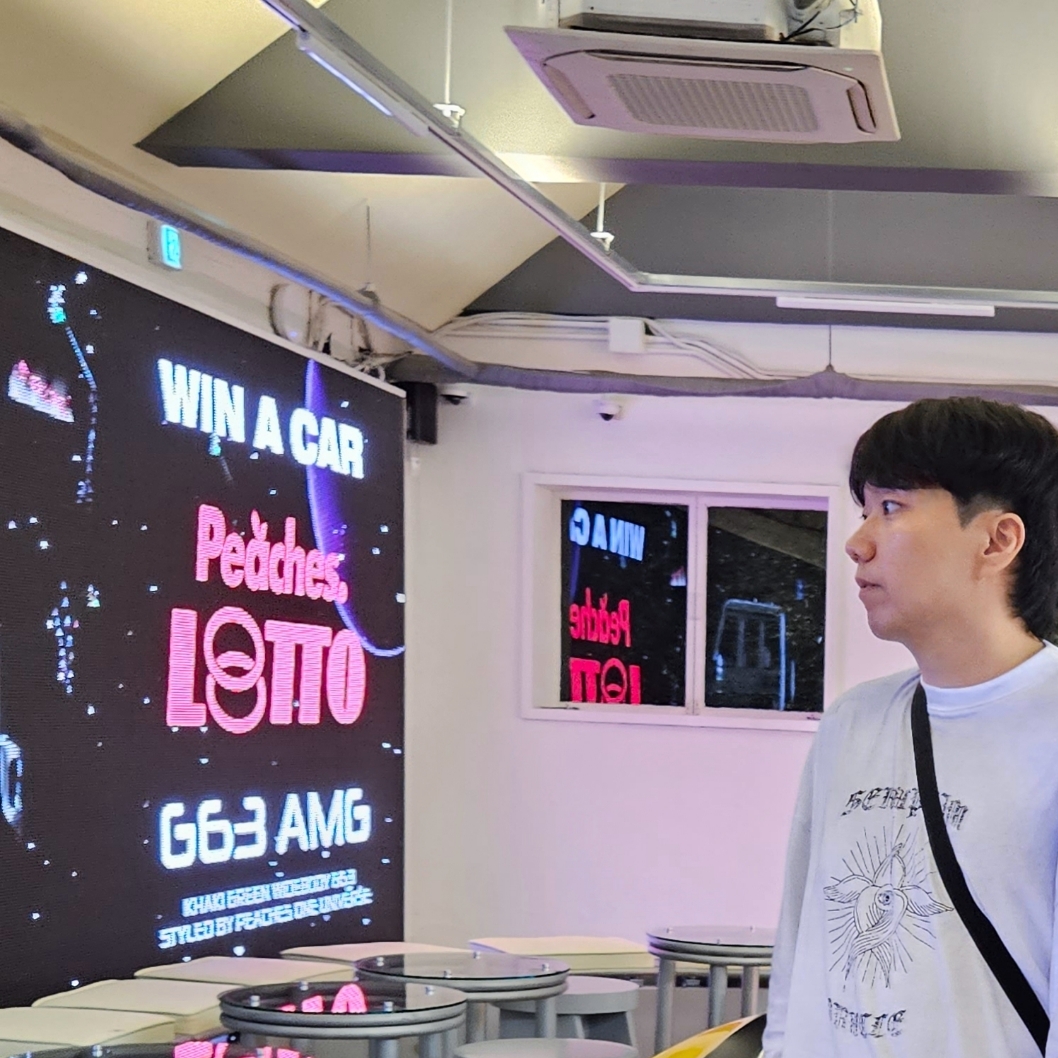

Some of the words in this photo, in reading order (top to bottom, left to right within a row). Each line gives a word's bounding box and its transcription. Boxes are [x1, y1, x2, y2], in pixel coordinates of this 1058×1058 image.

[157, 358, 245, 443] WIN
[253, 395, 284, 455] A
[289, 407, 365, 480] CAR
[166, 606, 366, 734] LOTTO
[159, 796, 267, 869] G63
[274, 788, 371, 855] AMG
